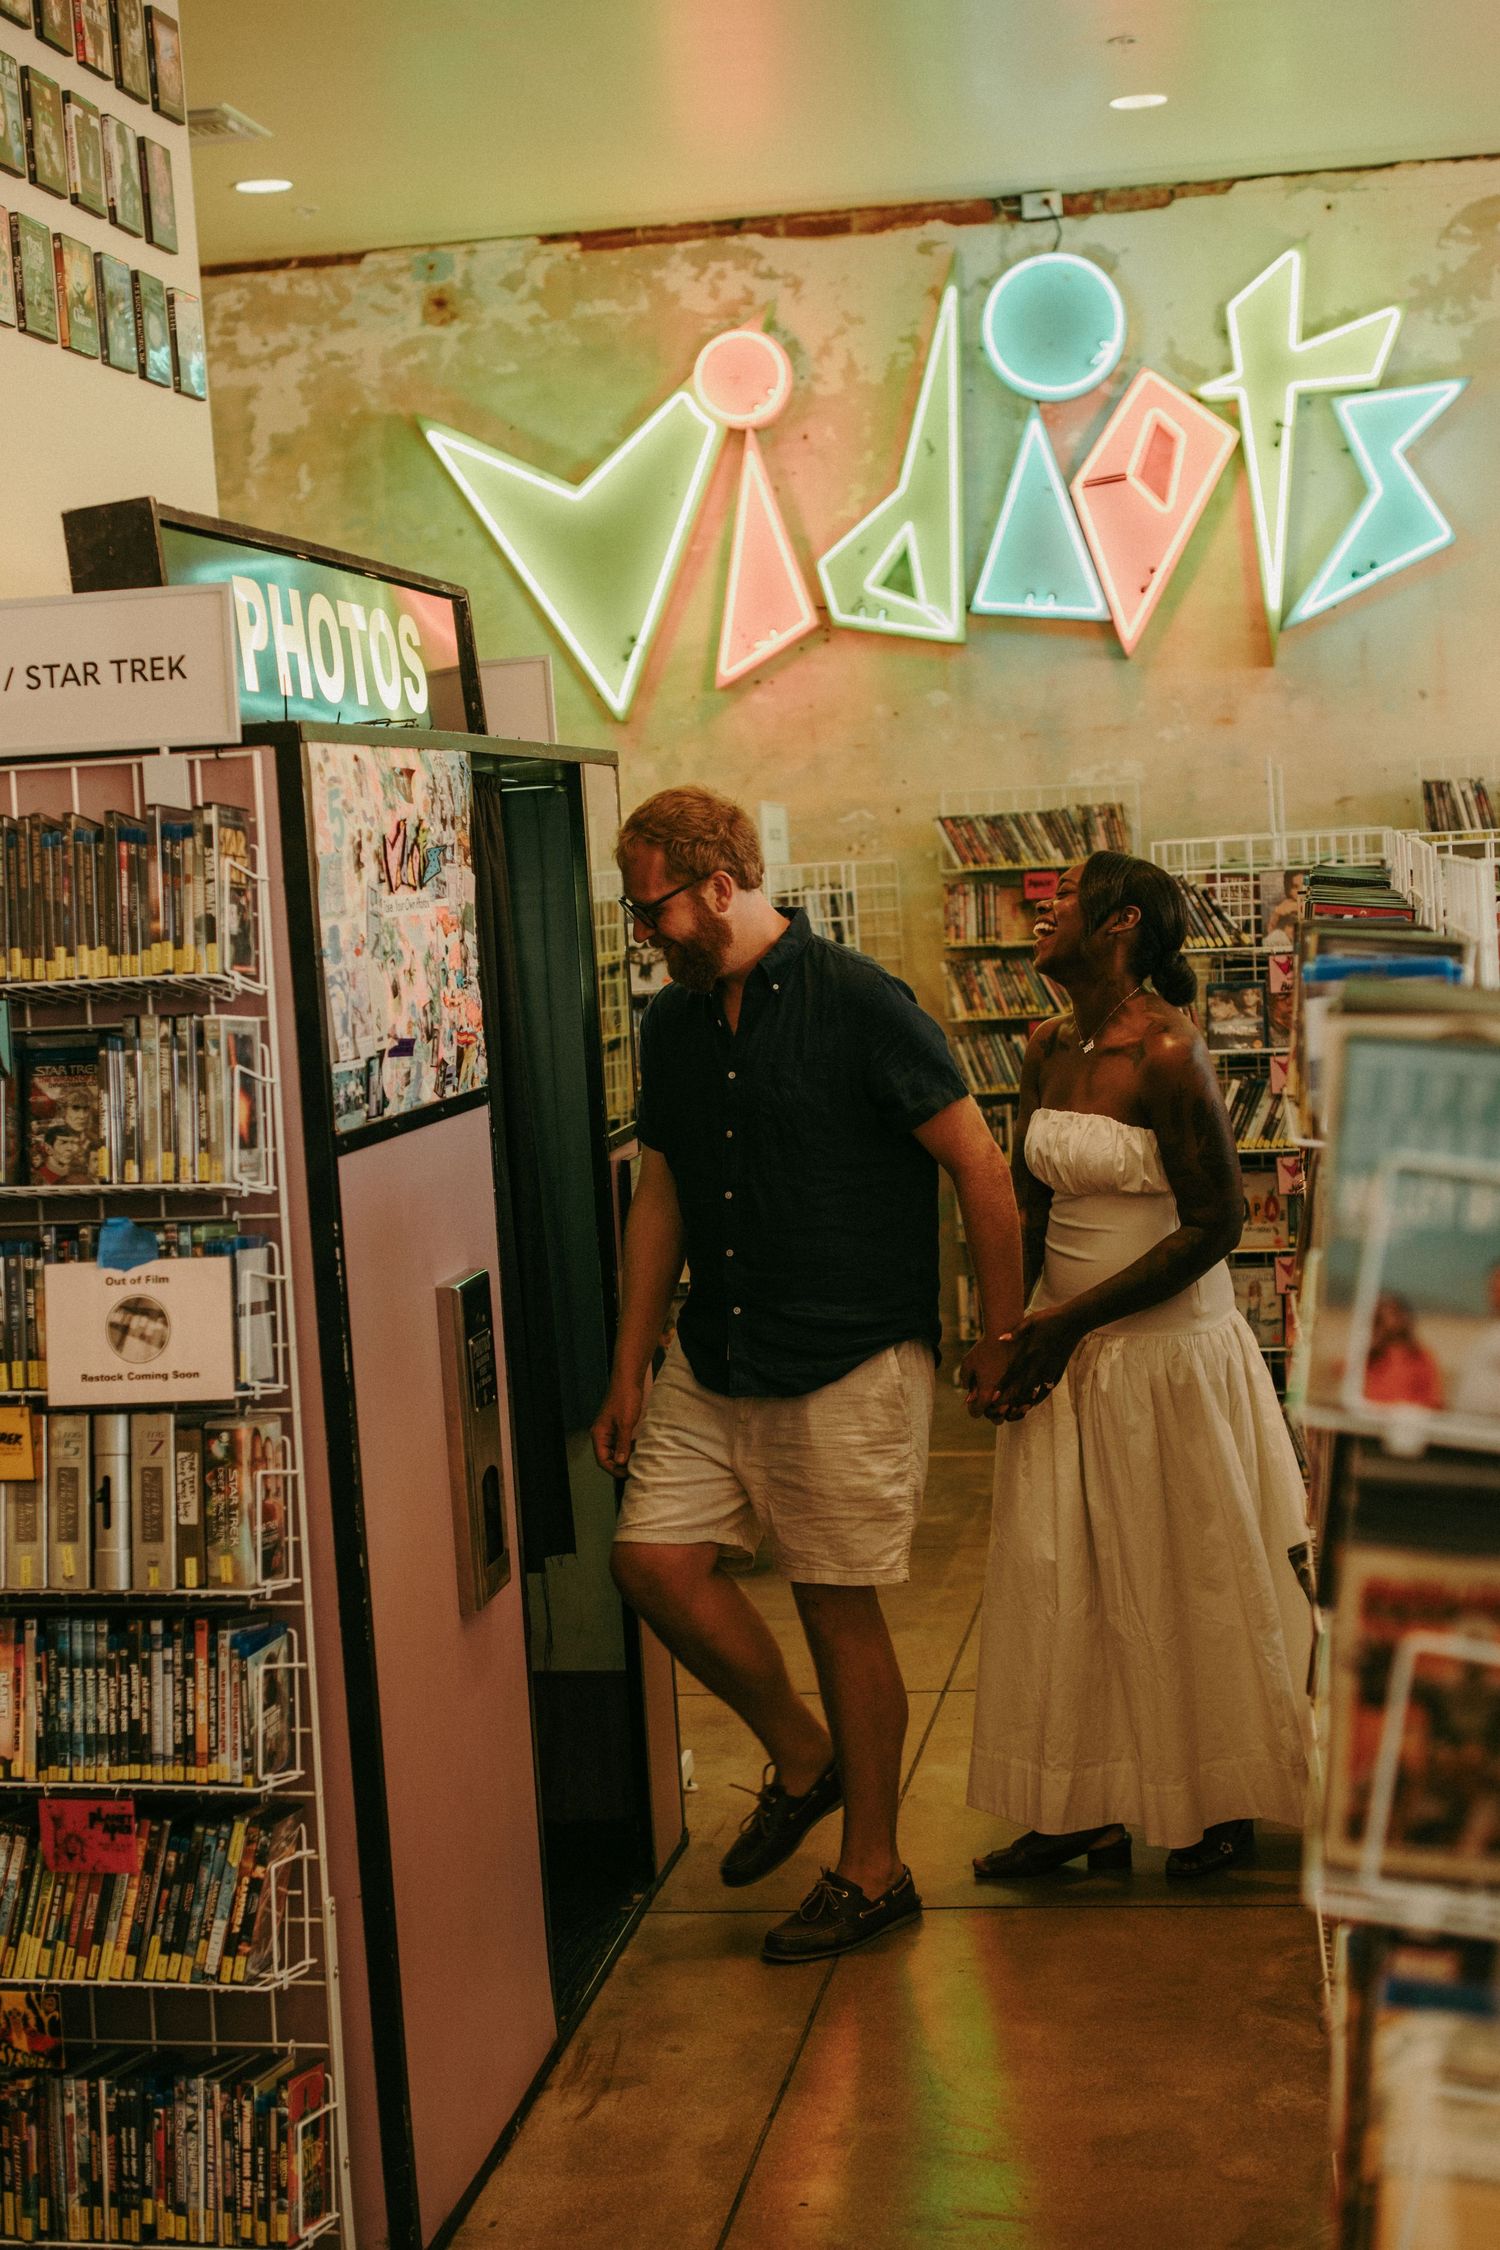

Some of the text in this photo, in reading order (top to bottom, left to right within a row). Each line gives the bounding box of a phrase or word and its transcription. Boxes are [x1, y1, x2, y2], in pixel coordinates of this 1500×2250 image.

[232, 575, 429, 714] PHOTOS
[25, 661, 102, 691] STAR
[109, 654, 188, 683] TREK
[204, 848, 215, 877] STAR
[32, 1063, 98, 1077] STAR TRE
[105, 1275, 170, 1286] Out of Film
[81, 1370, 200, 1383] Restock Coming Soon
[149, 1440, 165, 1456] 7
[217, 1467, 226, 1492] DEEP
[217, 1494, 226, 1523] SPACE
[228, 1469, 241, 1548] STAR TREK
[73, 1668, 84, 1703] PLANET
[85, 1668, 97, 1703] PLANET
[97, 1668, 109, 1703] PLANET
[197, 1658, 208, 1694] PLANET
[58, 1667, 70, 1733] PLANET APES
[109, 1677, 117, 1710] PLANET
[120, 1674, 129, 1733] PLANET APES
[141, 1677, 150, 1710] PLANET
[186, 1677, 194, 1710] PLANET
[219, 1697, 227, 1725] PLANET
[231, 1707, 240, 1734] PLANET
[176, 2110, 186, 2138] SON
[242, 2104, 252, 2208] WARNING FROM SPACE
